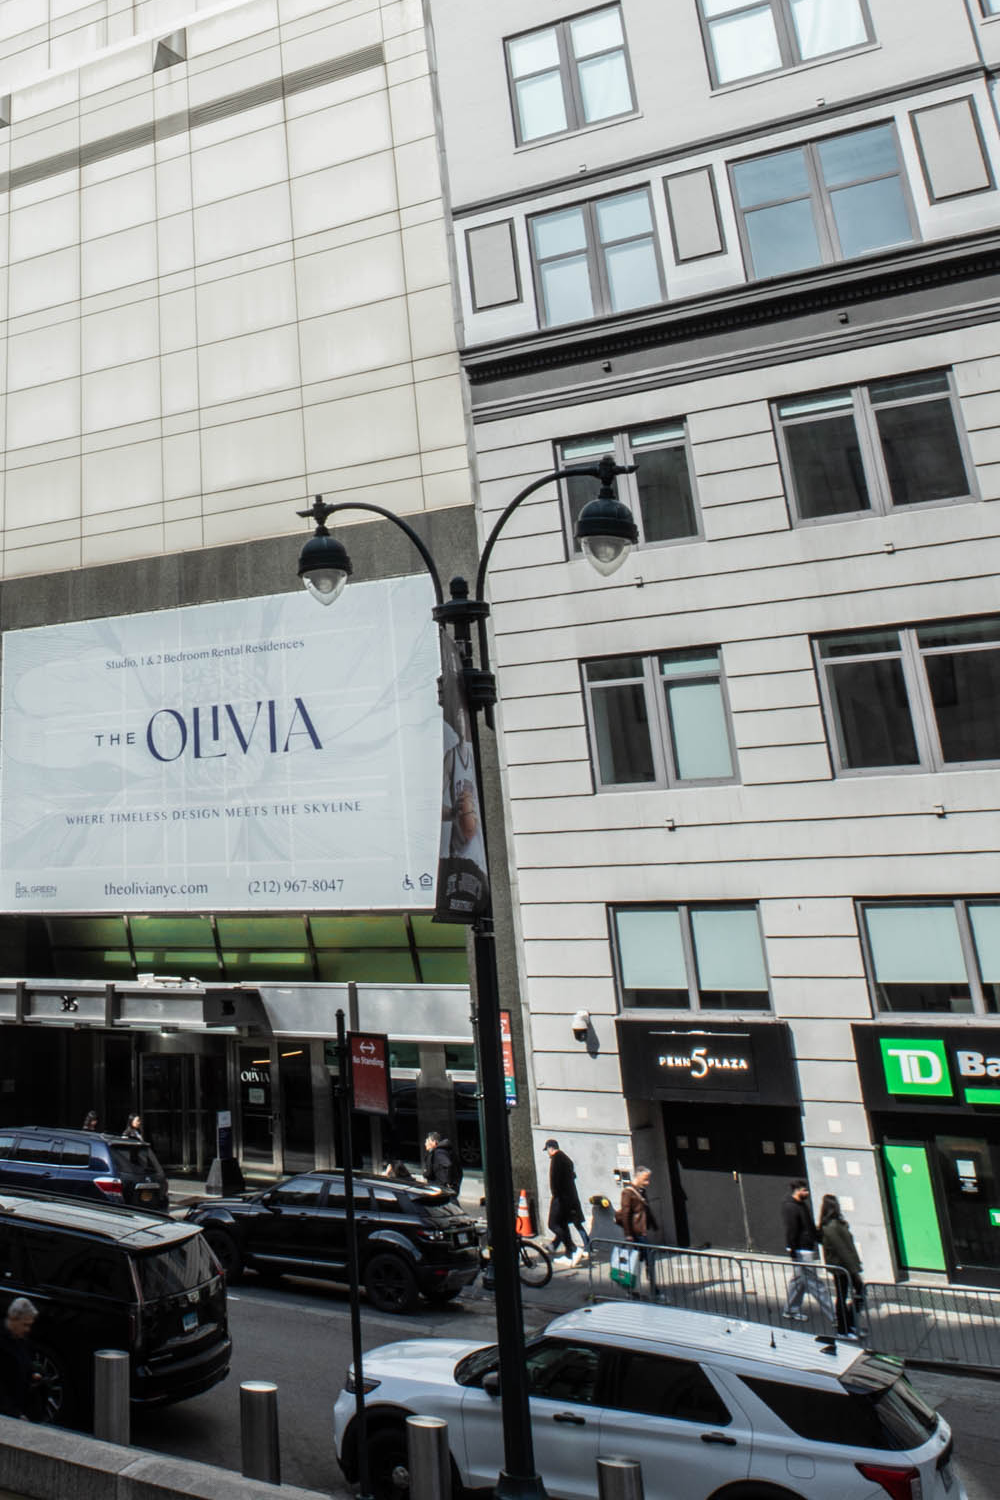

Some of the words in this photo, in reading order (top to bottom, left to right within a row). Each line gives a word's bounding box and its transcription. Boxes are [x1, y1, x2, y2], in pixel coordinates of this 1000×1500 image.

[105, 658, 139, 670] Studio,
[147, 657, 155, 666] &
[156, 656, 162, 665] 2
[164, 650, 210, 664] Bedroom
[211, 644, 244, 658] Rental
[245, 639, 305, 655] Residences
[95, 732, 136, 747] THE
[146, 697, 323, 762] OLIVIA
[66, 813, 105, 825] WHERE
[110, 811, 168, 823] TIMELESS
[172, 808, 220, 821] DESIGN
[225, 806, 268, 818] MEETS
[272, 804, 297, 816] THE
[303, 801, 362, 814] SKYLINE
[104, 881, 208, 898] theolivianyc.com
[248, 879, 281, 896] (212)
[284, 878, 344, 893] 967-8047
[361, 1056, 385, 1069] Standing
[659, 1056, 691, 1067] PENN
[691, 1047, 708, 1078] 5
[708, 1057, 748, 1070] PLAZA
[887, 1049, 943, 1084] TD
